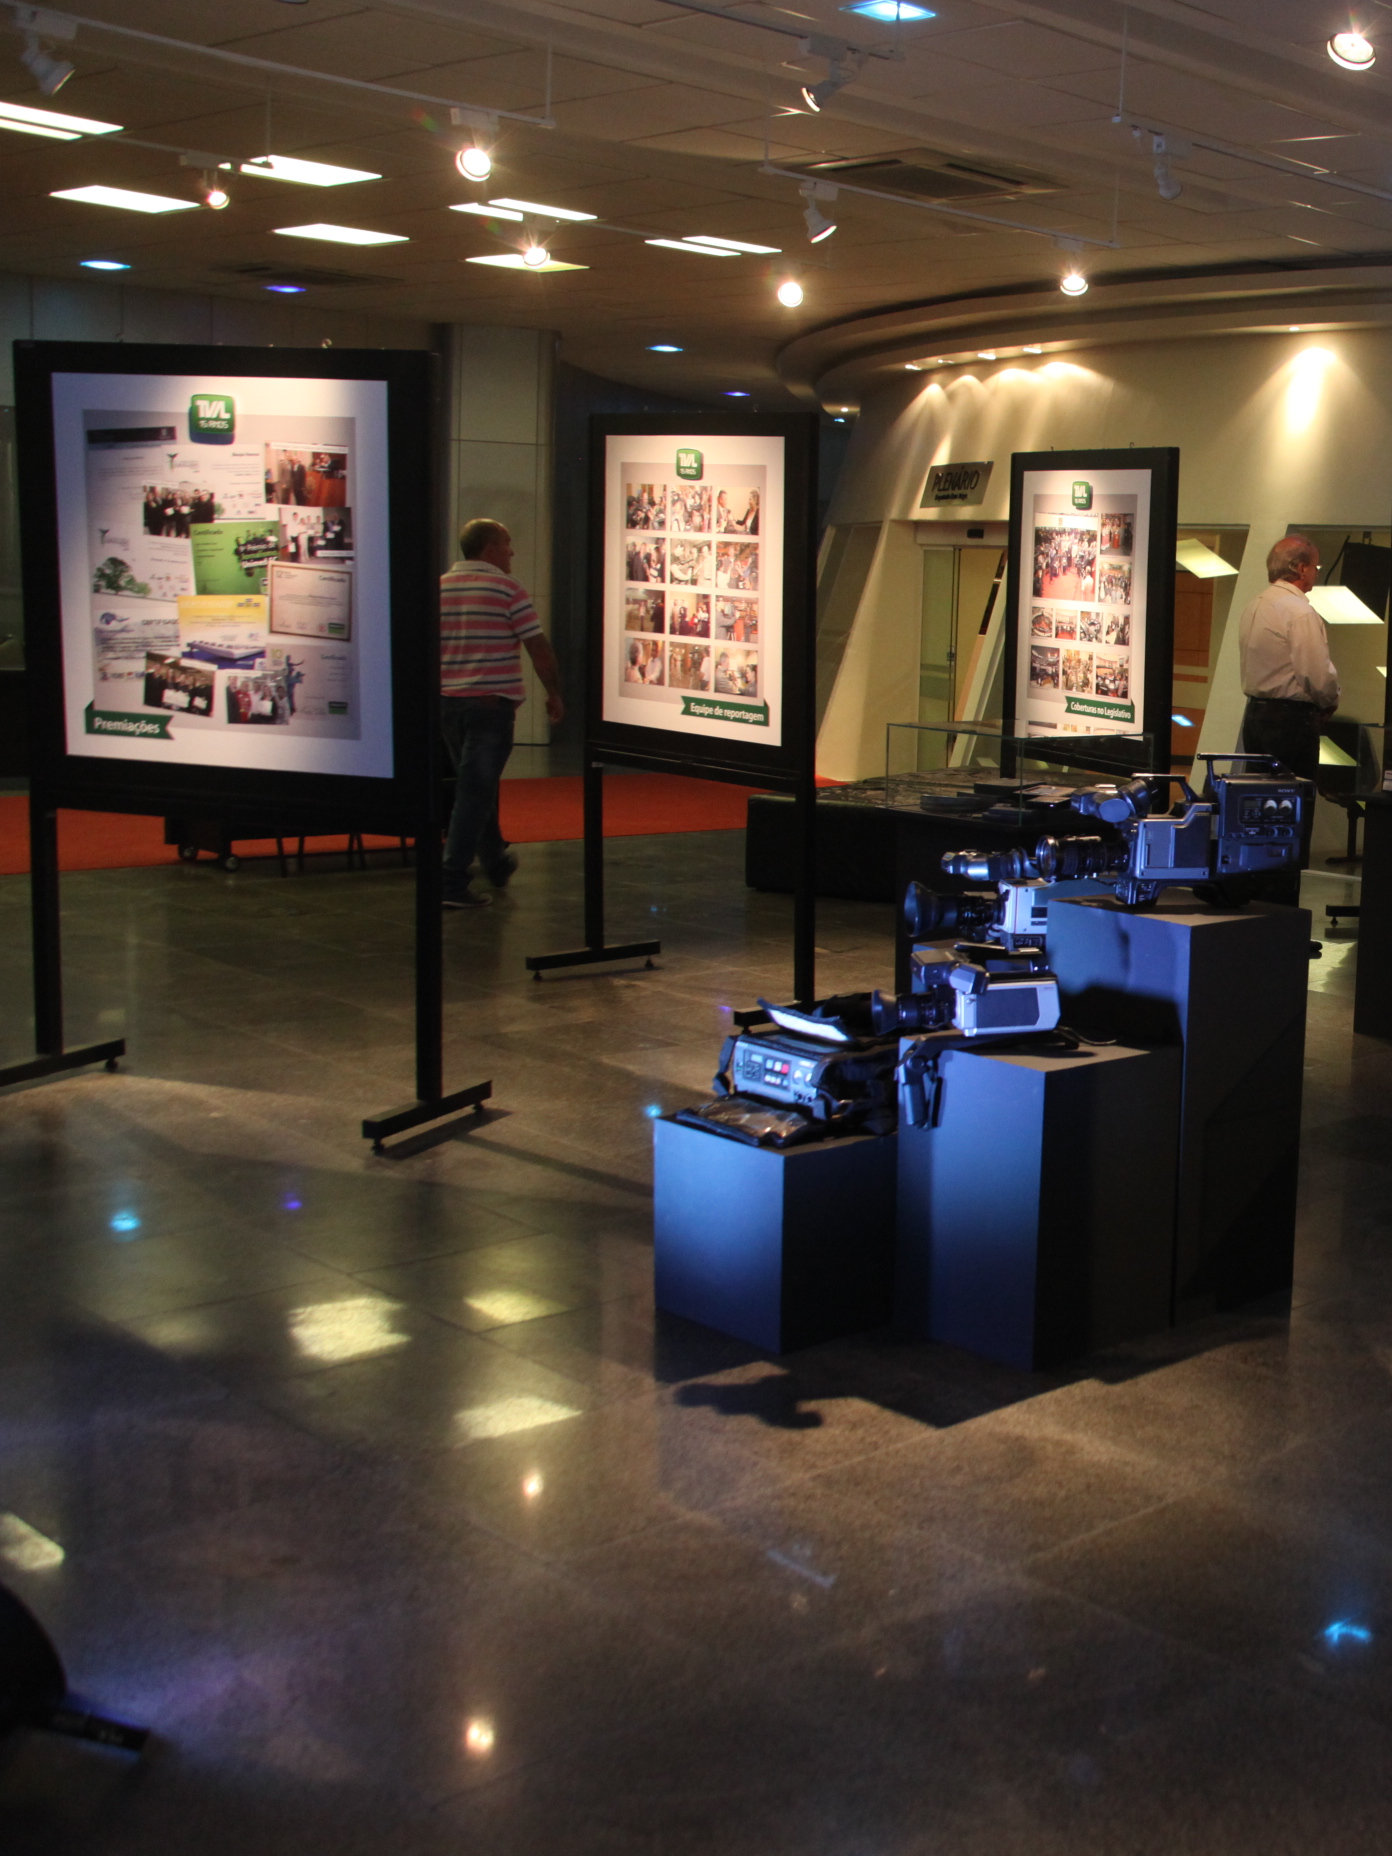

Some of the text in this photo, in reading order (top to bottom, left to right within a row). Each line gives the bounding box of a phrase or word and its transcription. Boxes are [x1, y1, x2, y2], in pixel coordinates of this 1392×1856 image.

[931, 465, 980, 492] PLENÁRIO
[690, 702, 764, 723] Equipe de reportagem
[1071, 701, 1131, 719] Coberturas no Legislativo
[93, 717, 160, 735] Premiações
